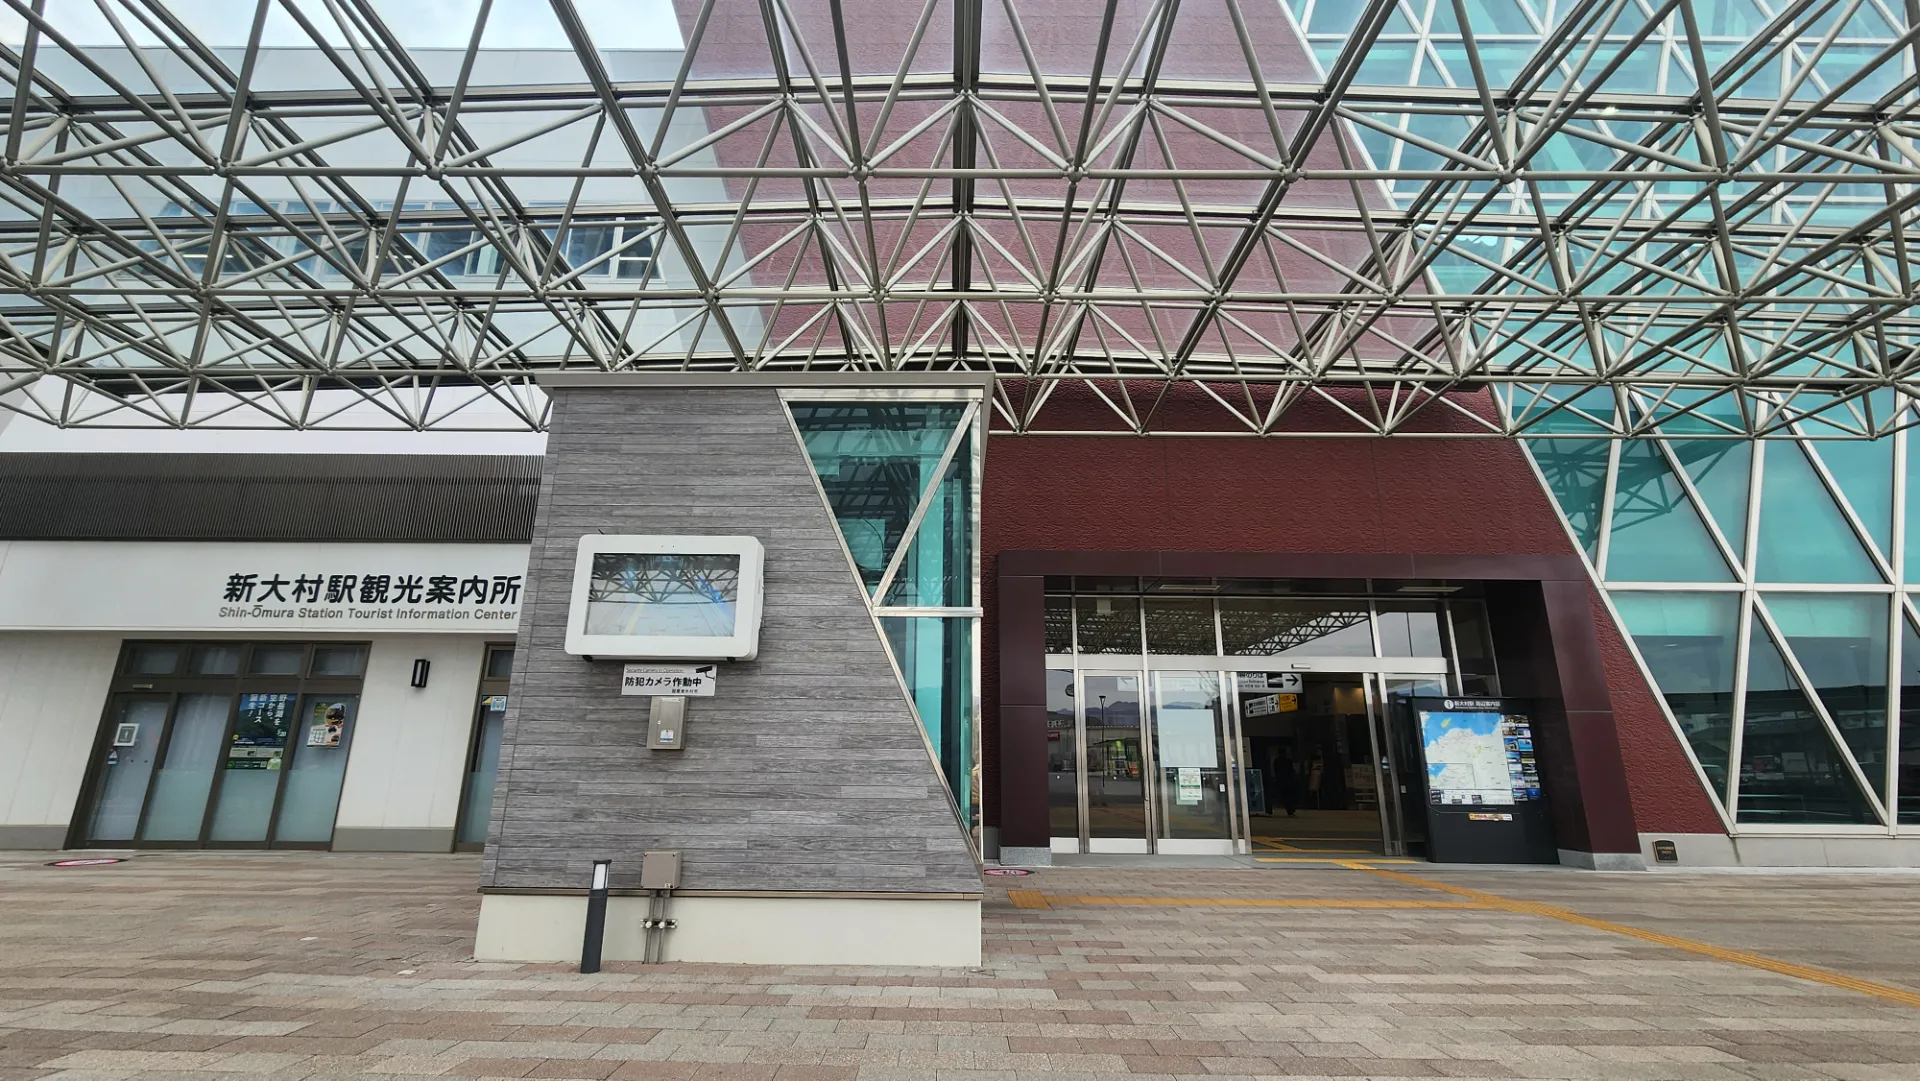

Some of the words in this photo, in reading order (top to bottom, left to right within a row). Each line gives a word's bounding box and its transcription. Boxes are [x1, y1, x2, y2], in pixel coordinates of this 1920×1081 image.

[223, 573, 522, 604] 新大村駅観光案内所
[219, 604, 294, 618] Shin-Ōmura
[298, 607, 343, 618] Station
[348, 608, 393, 618] Tourist
[396, 608, 469, 619] Information
[474, 608, 517, 619] Center
[625, 677, 701, 687] 防犯カメラ作動中
